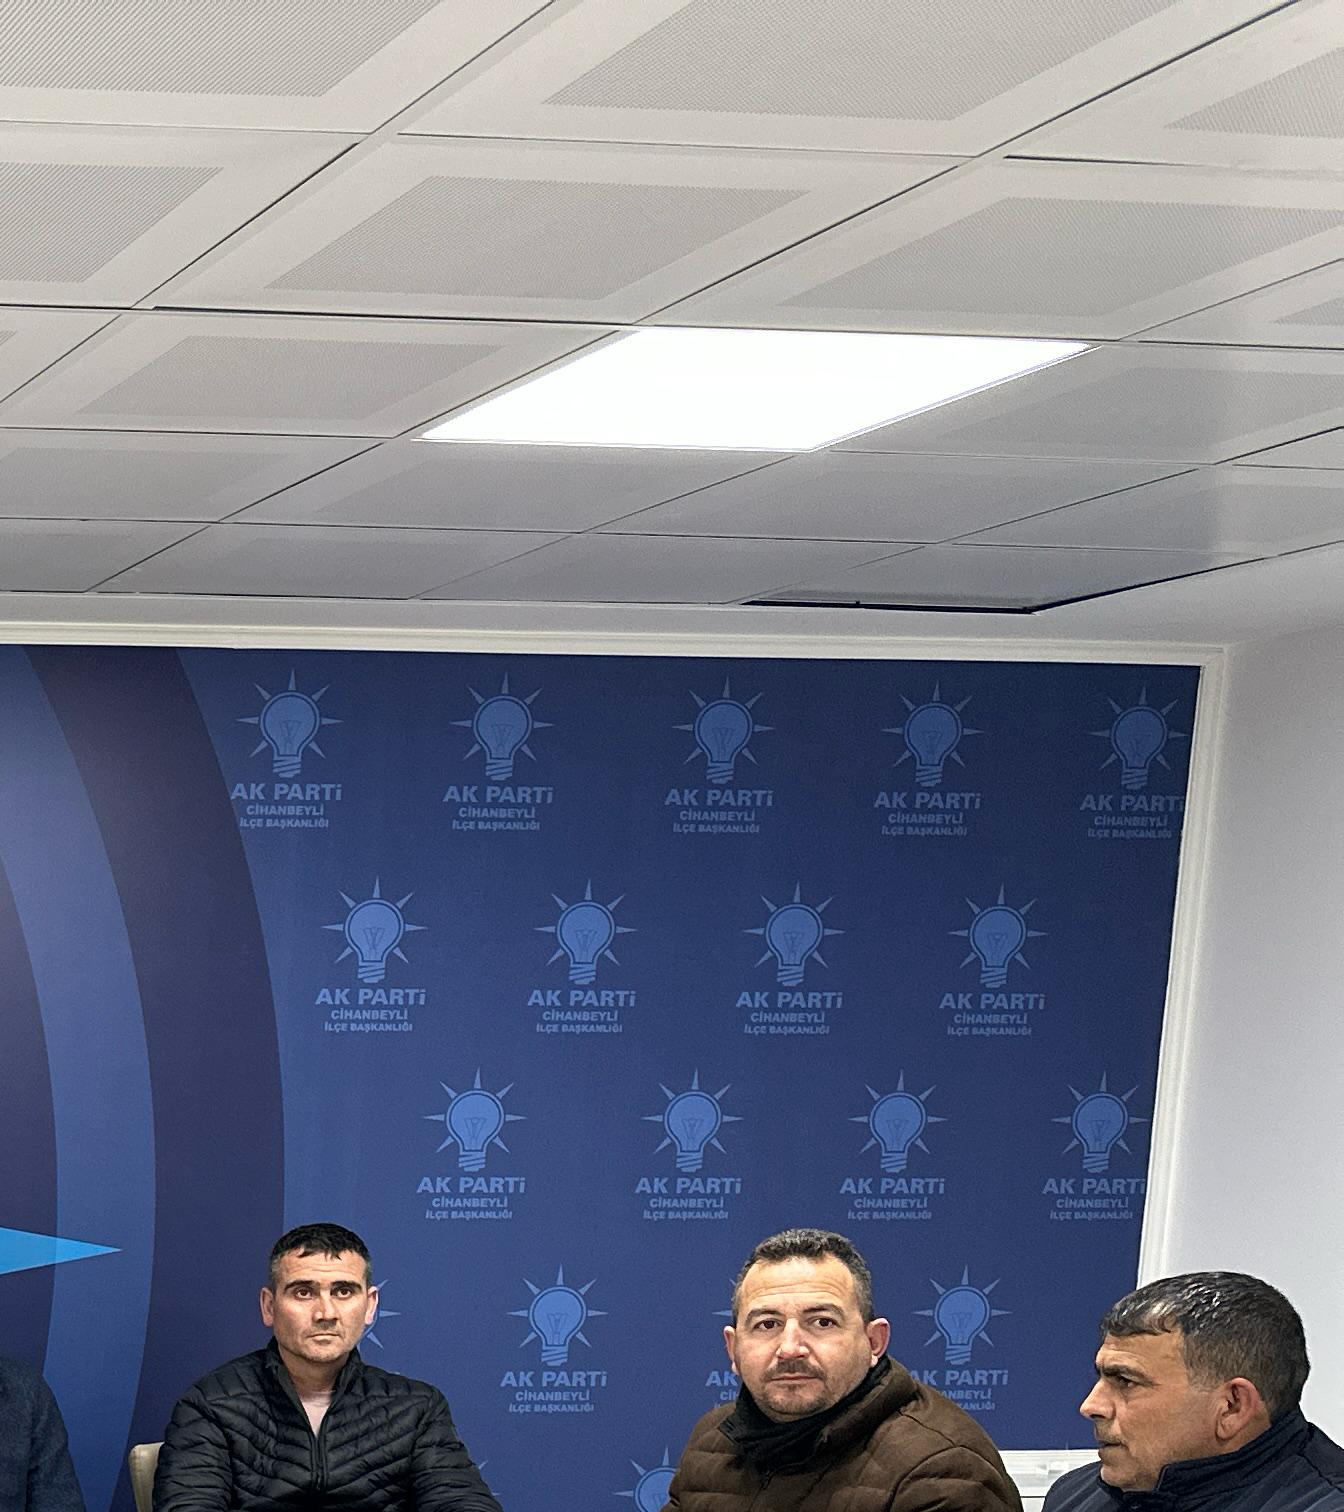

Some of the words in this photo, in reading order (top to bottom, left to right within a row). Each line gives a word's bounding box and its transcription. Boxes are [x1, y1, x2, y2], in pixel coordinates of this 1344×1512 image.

[230, 783, 266, 800] AK
[442, 785, 478, 803] AK
[665, 789, 700, 805] AK
[874, 791, 908, 808] AK
[246, 804, 324, 816] CİHANBEYLİ
[1079, 795, 1113, 811] AK
[458, 806, 535, 819] CİHANBEYLİ
[315, 988, 350, 1005] AK
[527, 989, 562, 1006] AK
[736, 991, 770, 1007] AK
[939, 992, 973, 1009] AK
[330, 1008, 408, 1020] CİHANBEYLİ
[542, 1009, 618, 1022] CİHANBEYLİ
[751, 1011, 825, 1023] CİHANBEYLİ
[416, 1177, 451, 1193] AK
[635, 1177, 669, 1194] AK
[840, 1177, 873, 1194] AK
[1042, 1177, 1075, 1194] AK
[432, 1196, 508, 1208] CİHANBEYLİ
[650, 1197, 724, 1209] CİHANBEYLİ
[854, 1197, 928, 1209] CİHANBEYLİ
[500, 1371, 534, 1387] AK
[705, 1370, 738, 1386] AK
[515, 1390, 590, 1402] CİHANBEYLİ
